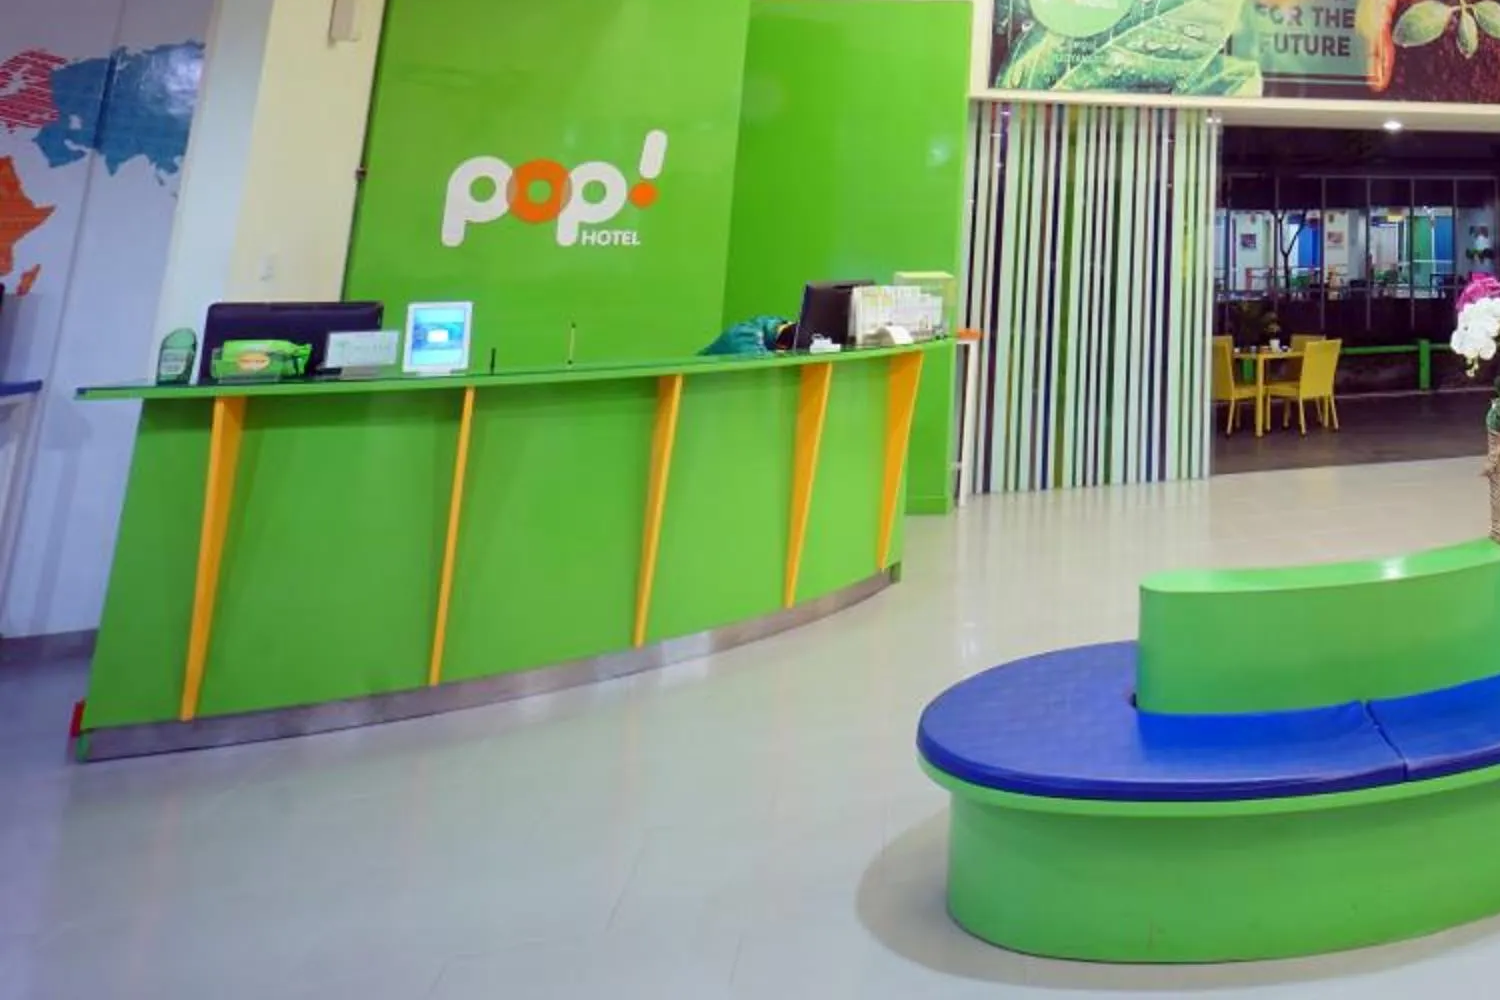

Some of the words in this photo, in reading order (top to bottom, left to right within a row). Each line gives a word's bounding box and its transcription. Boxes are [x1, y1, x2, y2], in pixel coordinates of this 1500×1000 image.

[1311, 6, 1356, 29] THE
[1260, 32, 1351, 57] FUTURE
[441, 129, 668, 247] pop!
[581, 230, 640, 246] HOTEL
